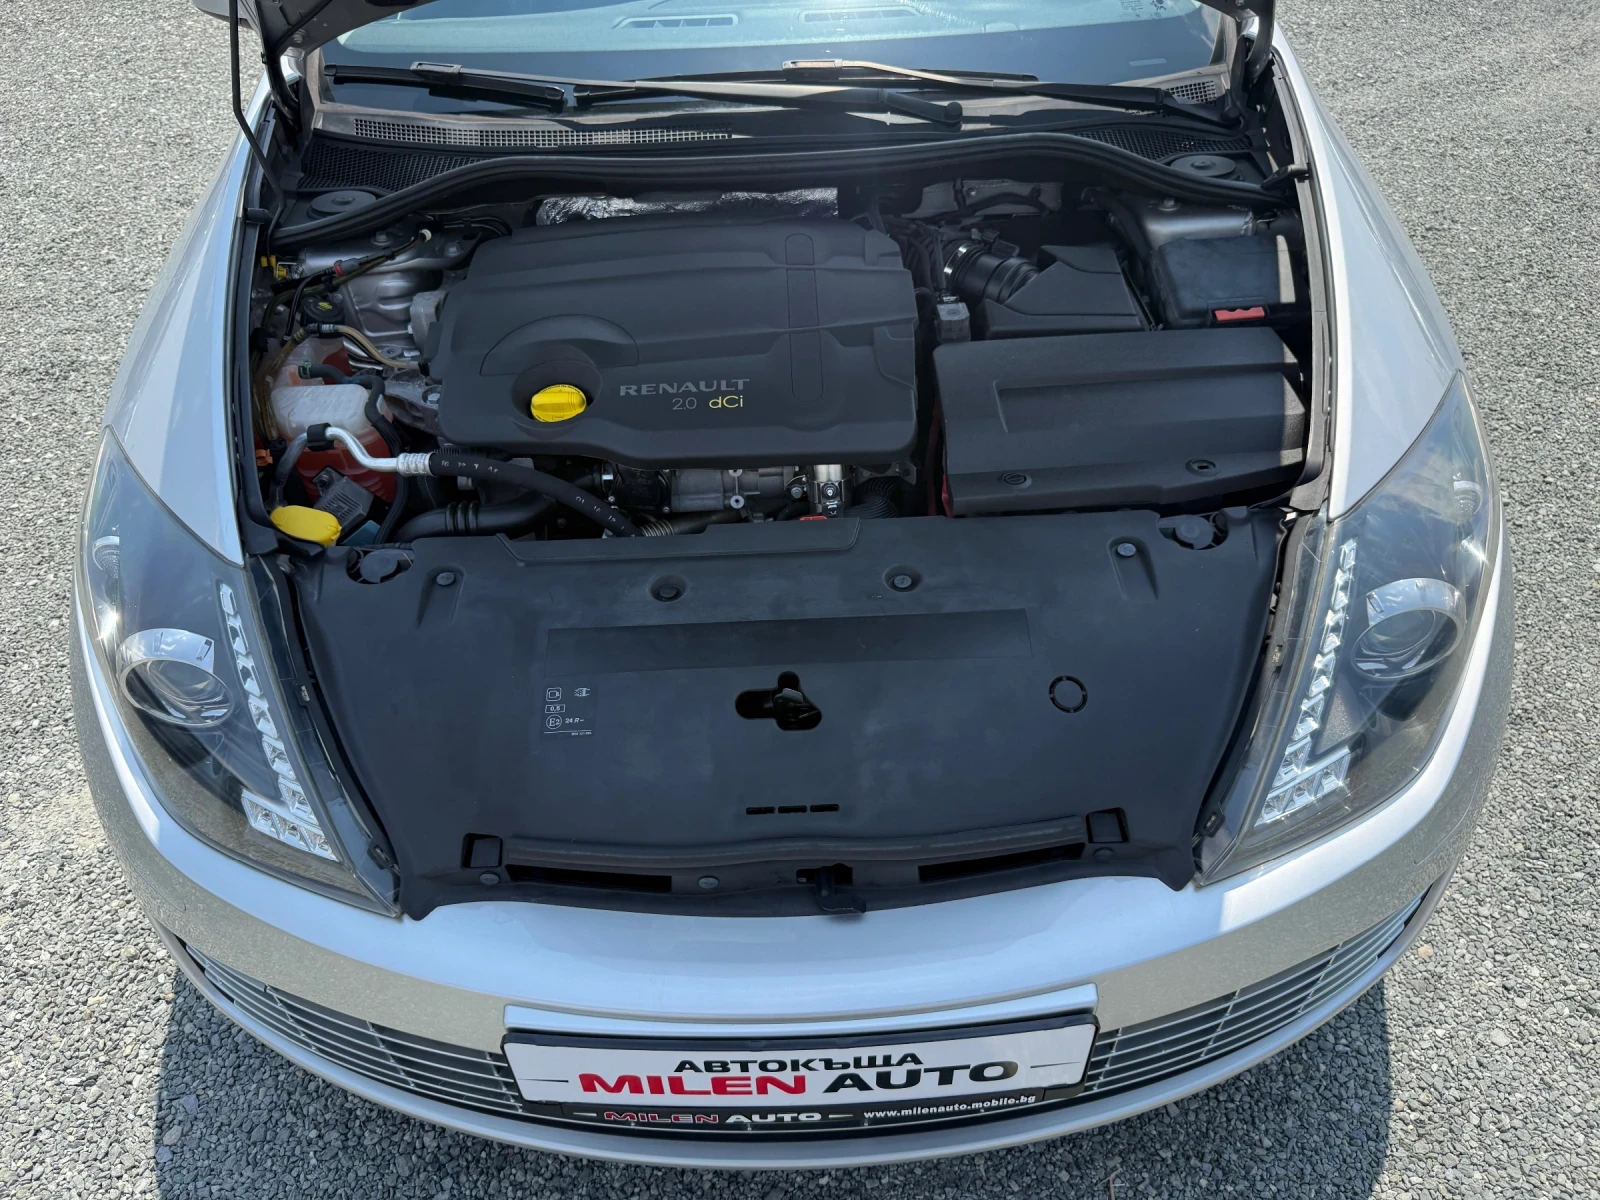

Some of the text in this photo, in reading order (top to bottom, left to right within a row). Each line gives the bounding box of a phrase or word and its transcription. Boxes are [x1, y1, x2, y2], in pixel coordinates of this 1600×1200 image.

[619, 379, 750, 396] RENAULT
[672, 395, 744, 410] 2.0 dCi
[673, 1052, 924, 1073] АВТОКЪЩА
[578, 1060, 1019, 1096] MILEN AUTO
[603, 1094, 1036, 1124] MILEN AUTO www.milenauto.mobile.bg
